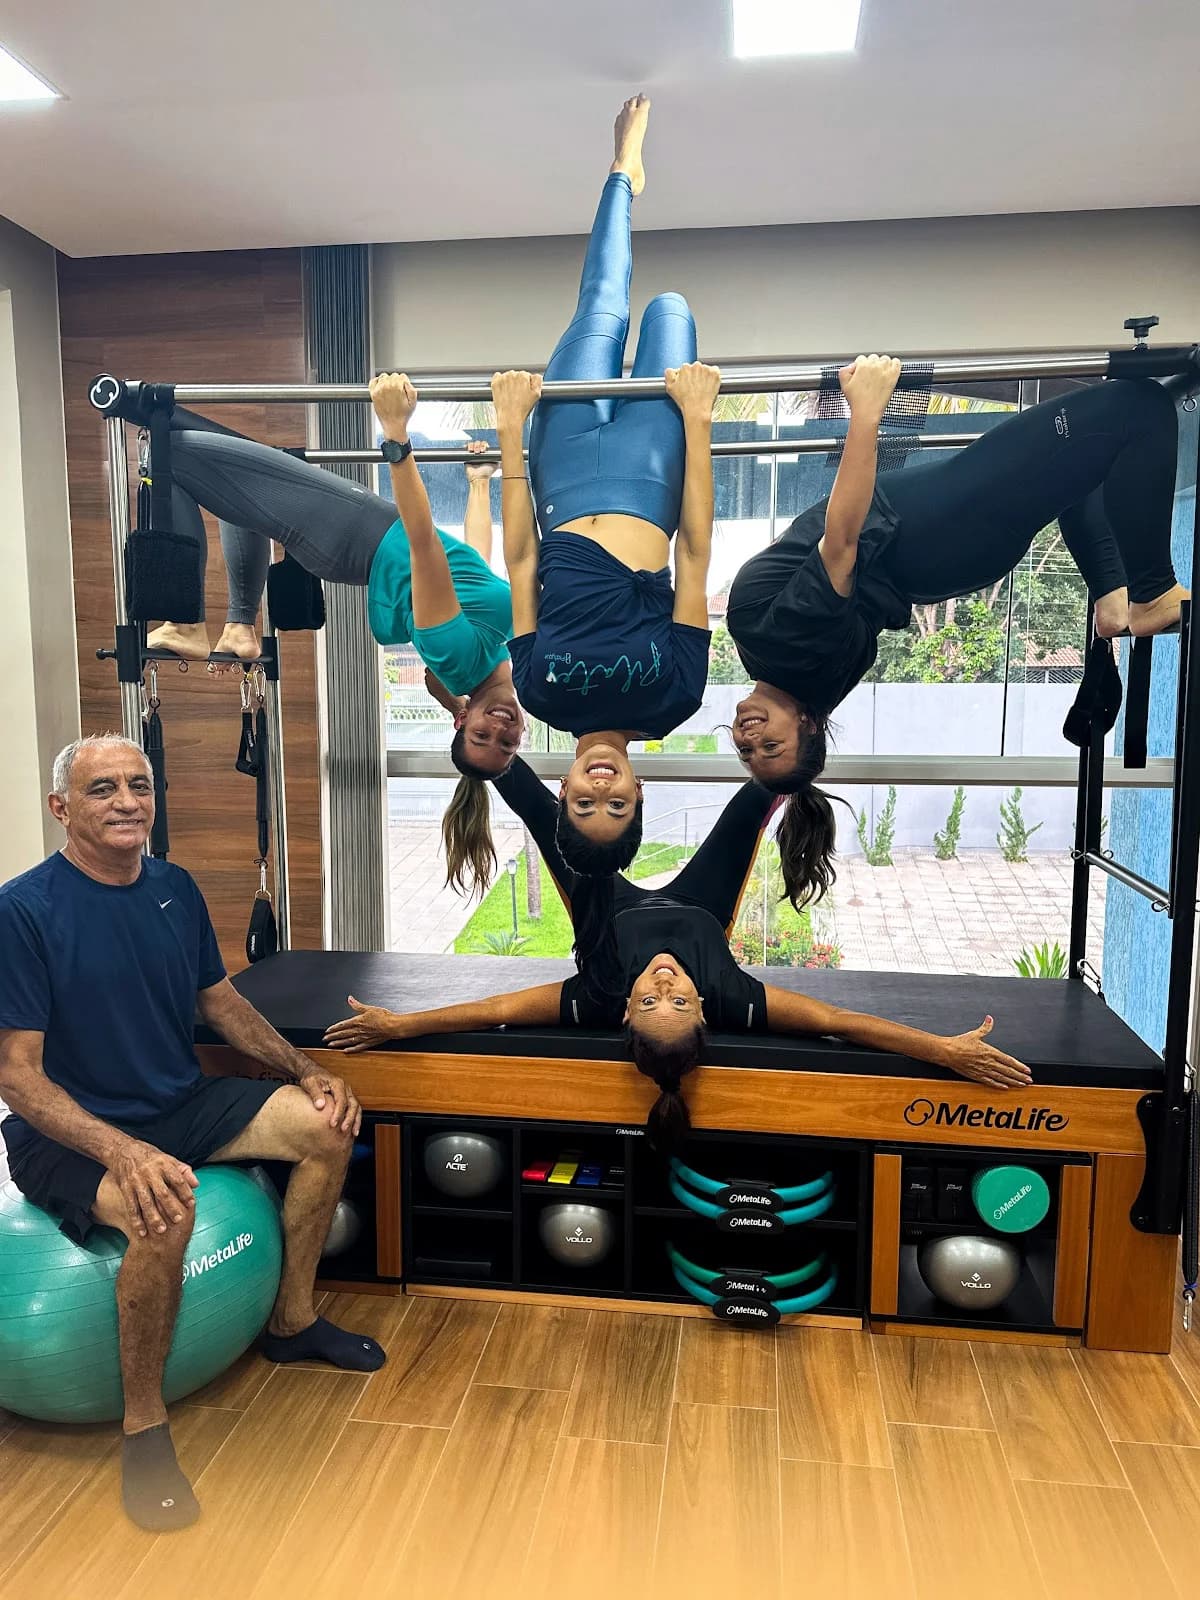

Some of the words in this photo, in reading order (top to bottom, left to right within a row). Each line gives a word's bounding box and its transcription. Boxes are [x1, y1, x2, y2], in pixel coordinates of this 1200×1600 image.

[935, 1102, 1070, 1132] MetaLife
[445, 1161, 467, 1171] ACTE
[737, 1194, 771, 1205] MetaLife
[1000, 1184, 1032, 1214] MetaLife
[738, 1218, 772, 1228] MetaLife
[565, 1236, 593, 1244] VOLLO
[190, 1232, 253, 1277] MetaLife
[961, 1280, 992, 1289] VOLLO
[734, 1306, 768, 1317] MetaLife
